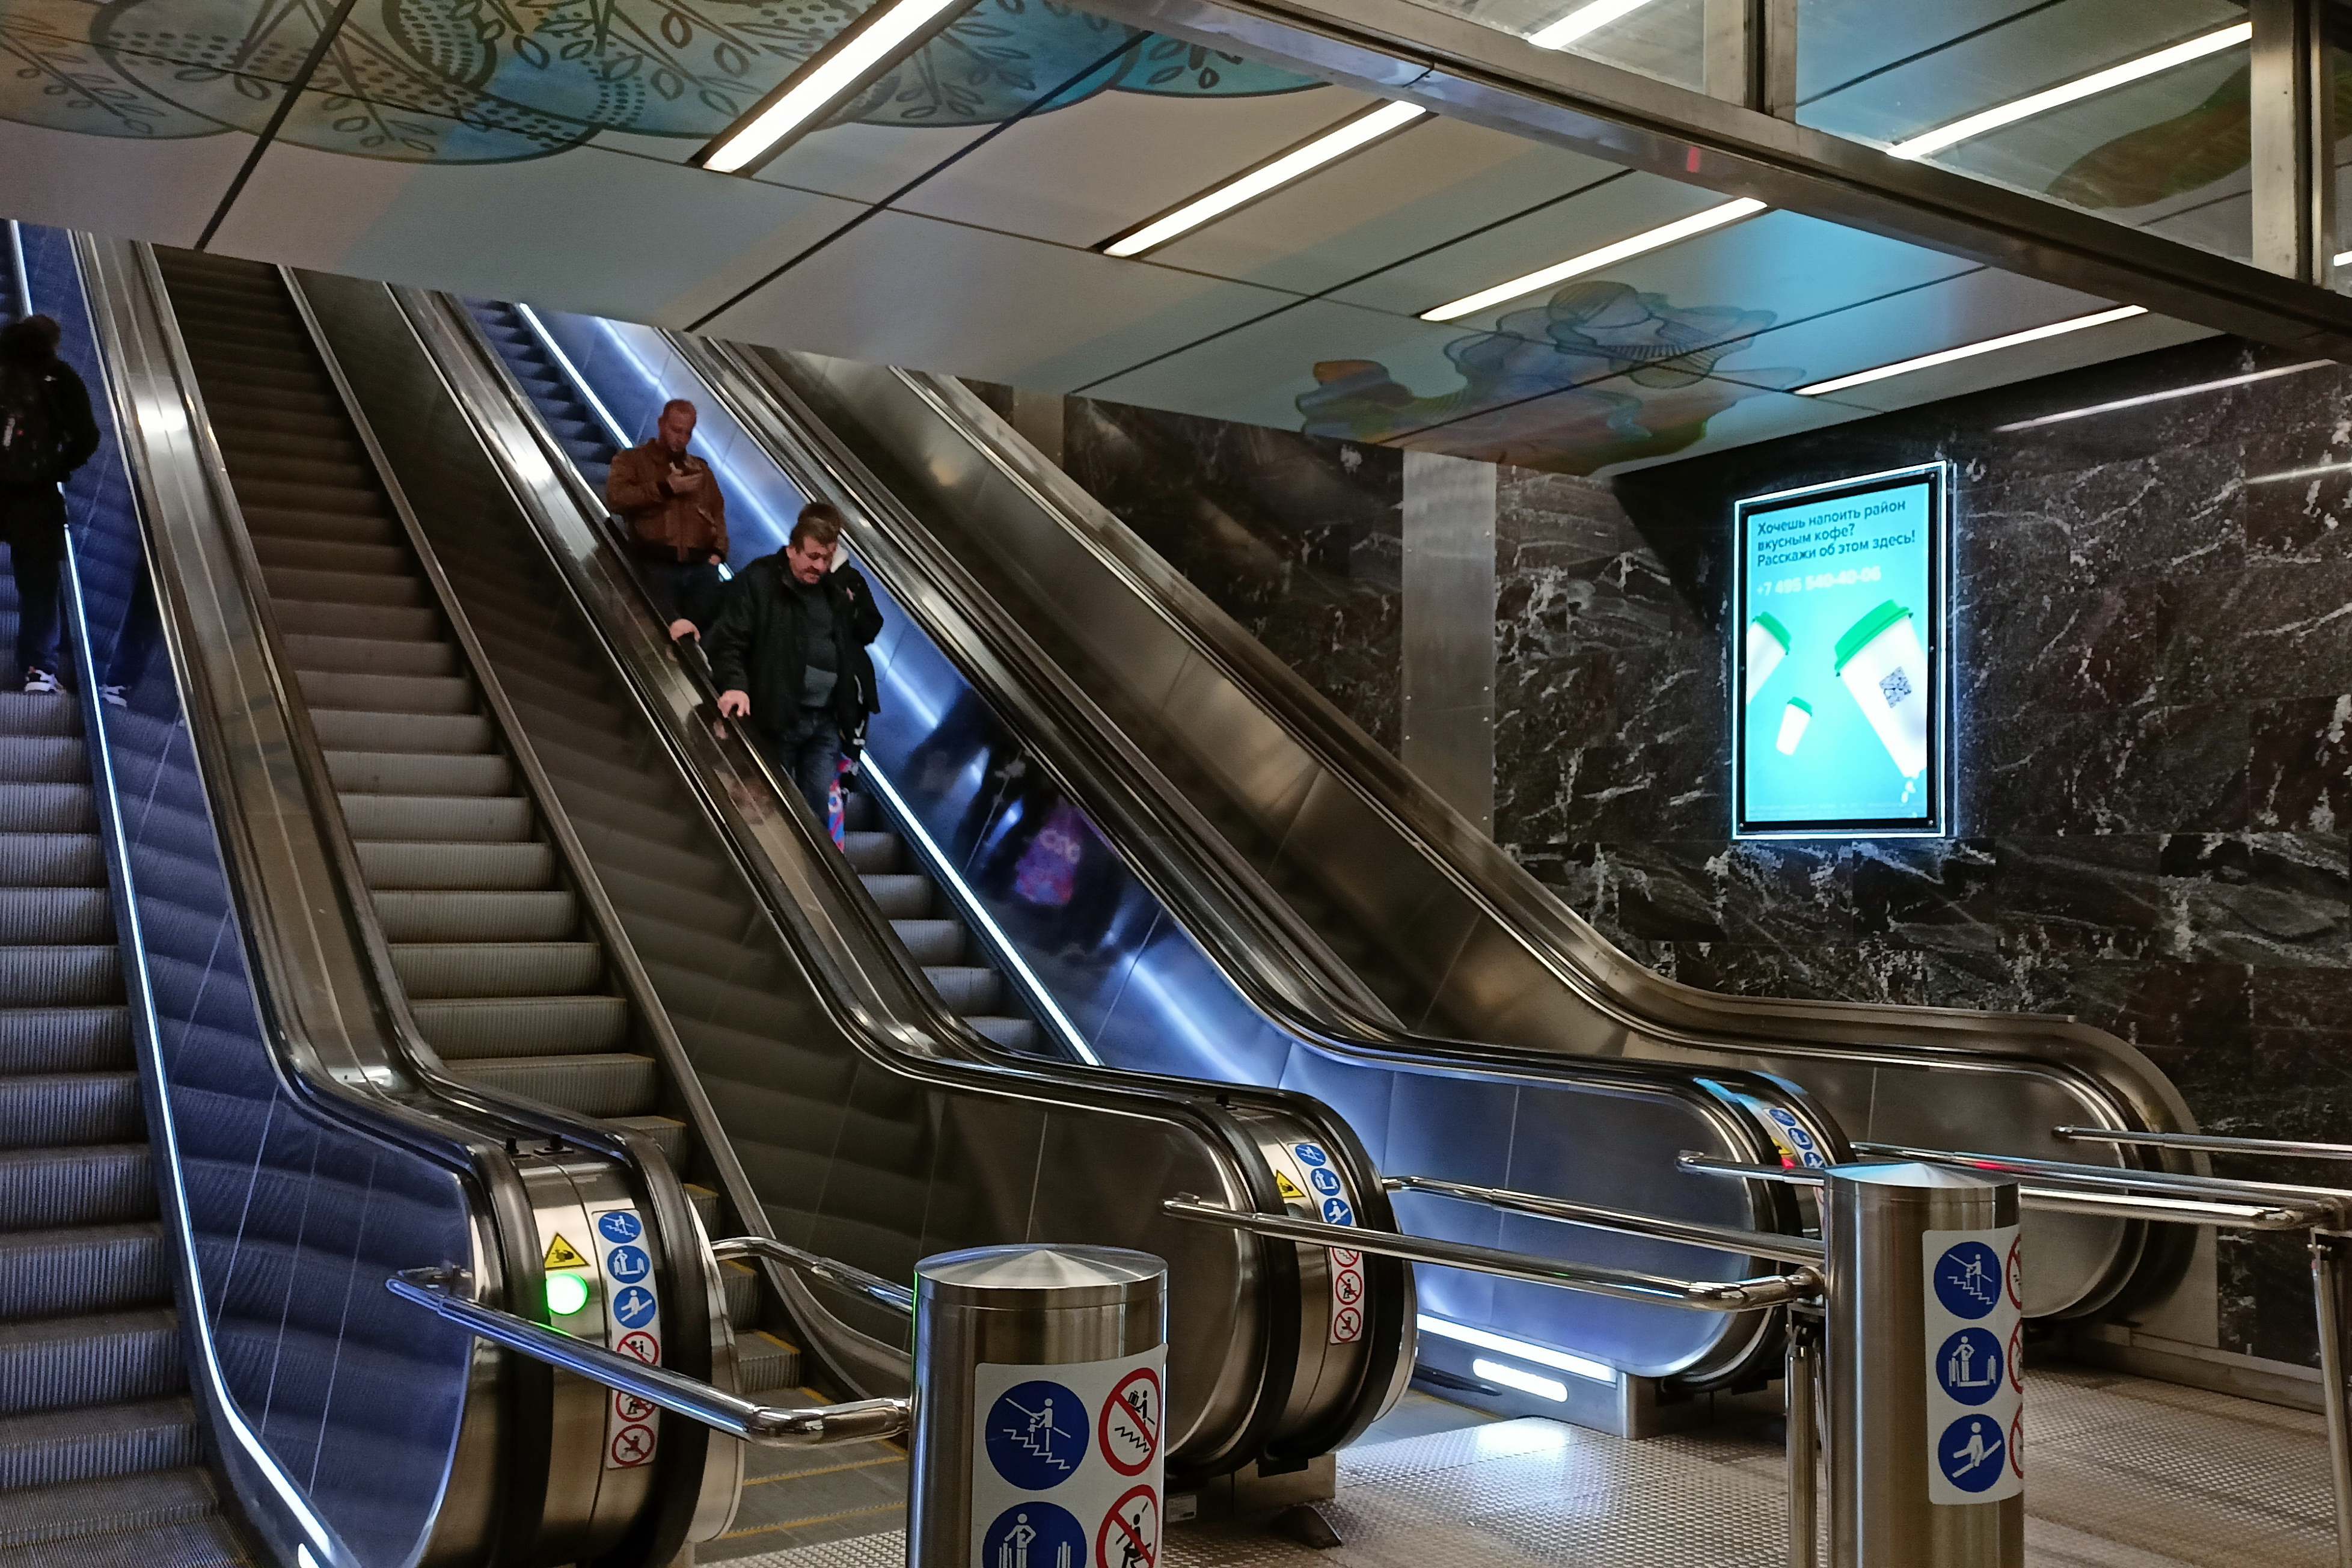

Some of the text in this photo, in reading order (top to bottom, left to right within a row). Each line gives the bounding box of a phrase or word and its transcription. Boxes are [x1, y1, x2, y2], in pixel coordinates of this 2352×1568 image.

[1757, 500, 1906, 536] Хочешь напоить район
[1757, 530, 1916, 567] Расскажи об этом здесь!
[1758, 523, 1855, 551] вкусным кофе?
